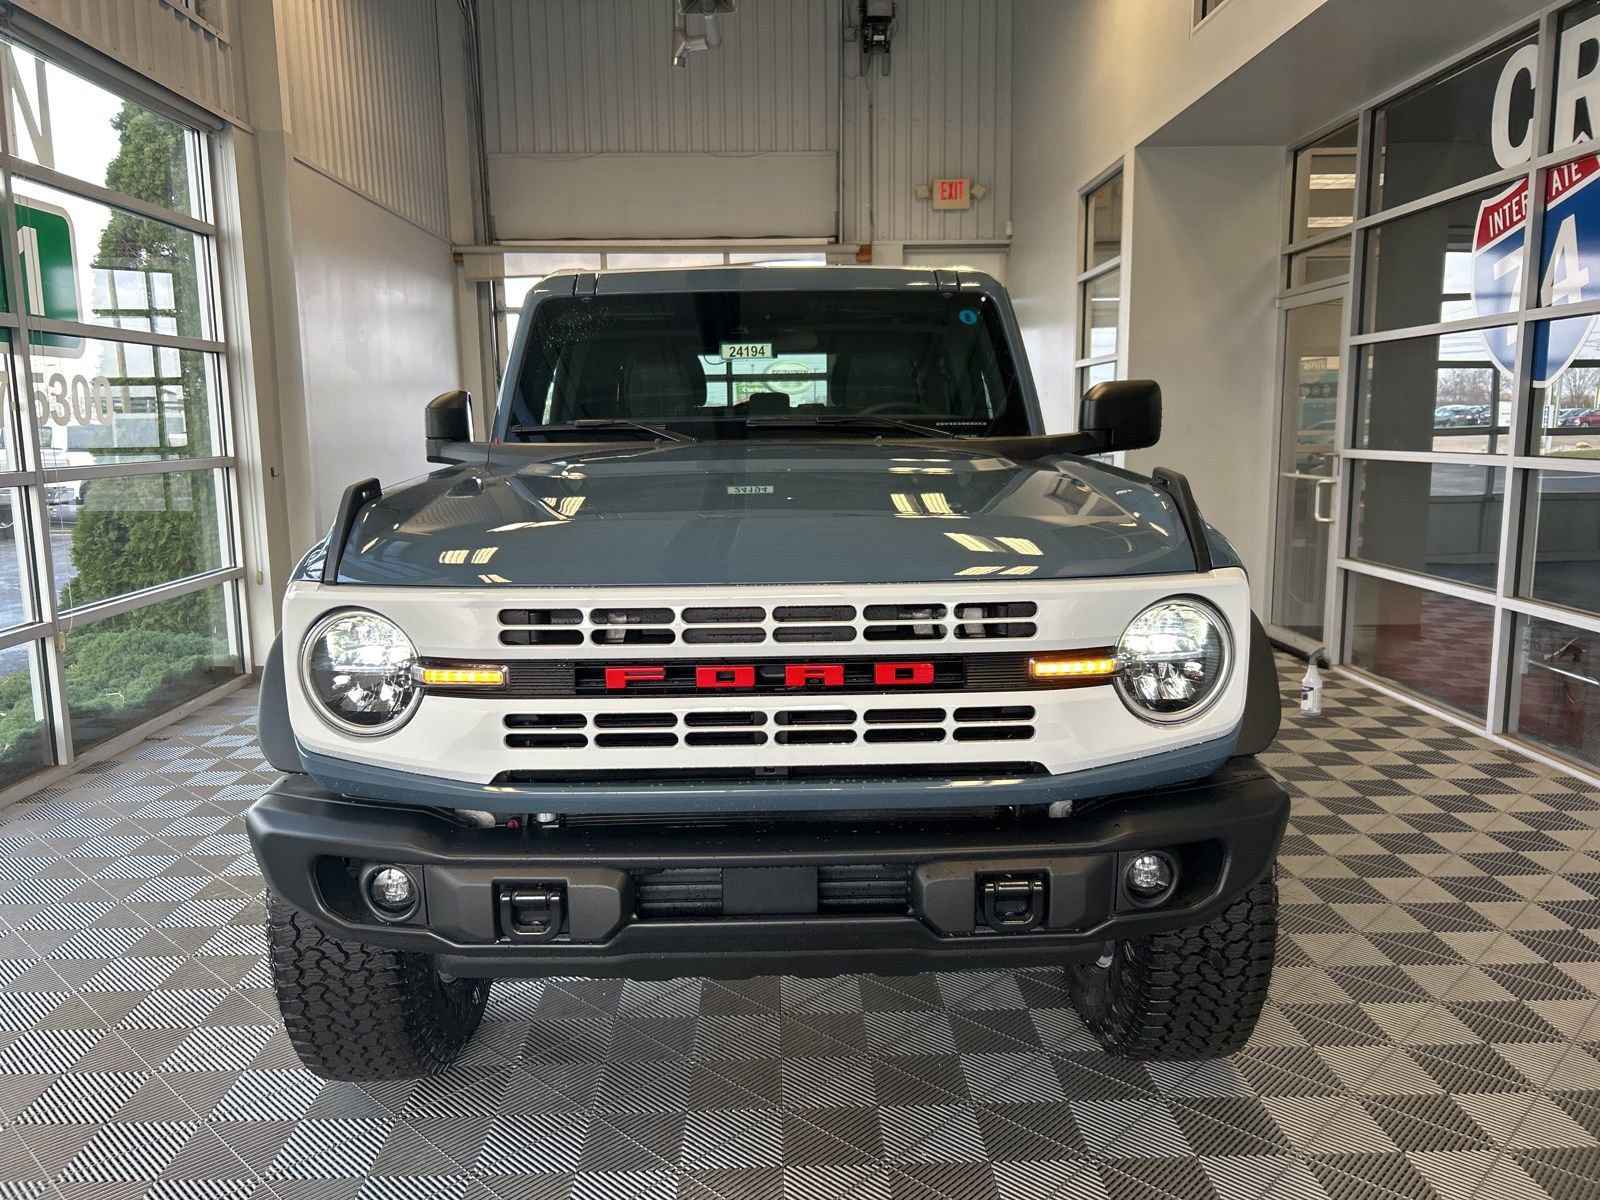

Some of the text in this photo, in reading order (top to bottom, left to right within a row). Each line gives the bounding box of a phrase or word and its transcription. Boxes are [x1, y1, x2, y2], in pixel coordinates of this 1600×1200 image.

[941, 181, 965, 200] EXIT
[729, 345, 766, 358] 24194
[605, 662, 935, 690] FORD
